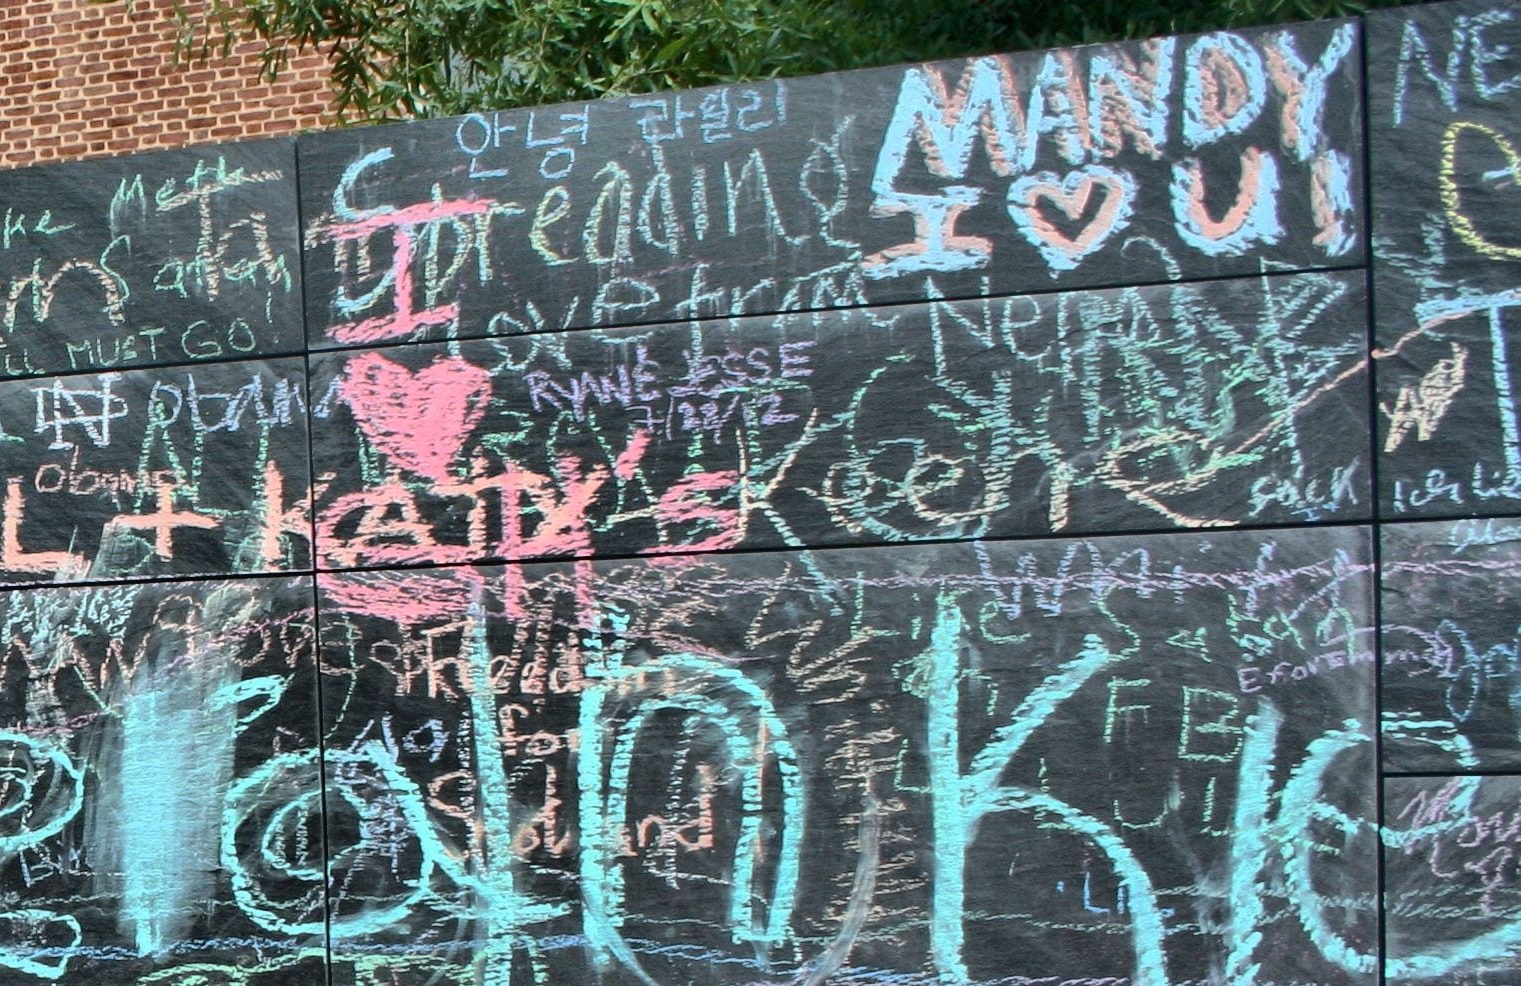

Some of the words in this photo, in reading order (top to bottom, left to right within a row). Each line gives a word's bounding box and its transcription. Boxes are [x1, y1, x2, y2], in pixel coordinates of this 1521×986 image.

[455, 103, 590, 181] 안녕
[871, 20, 1358, 197] MANDY
[862, 186, 993, 280] I
[66, 326, 166, 370] MUST
